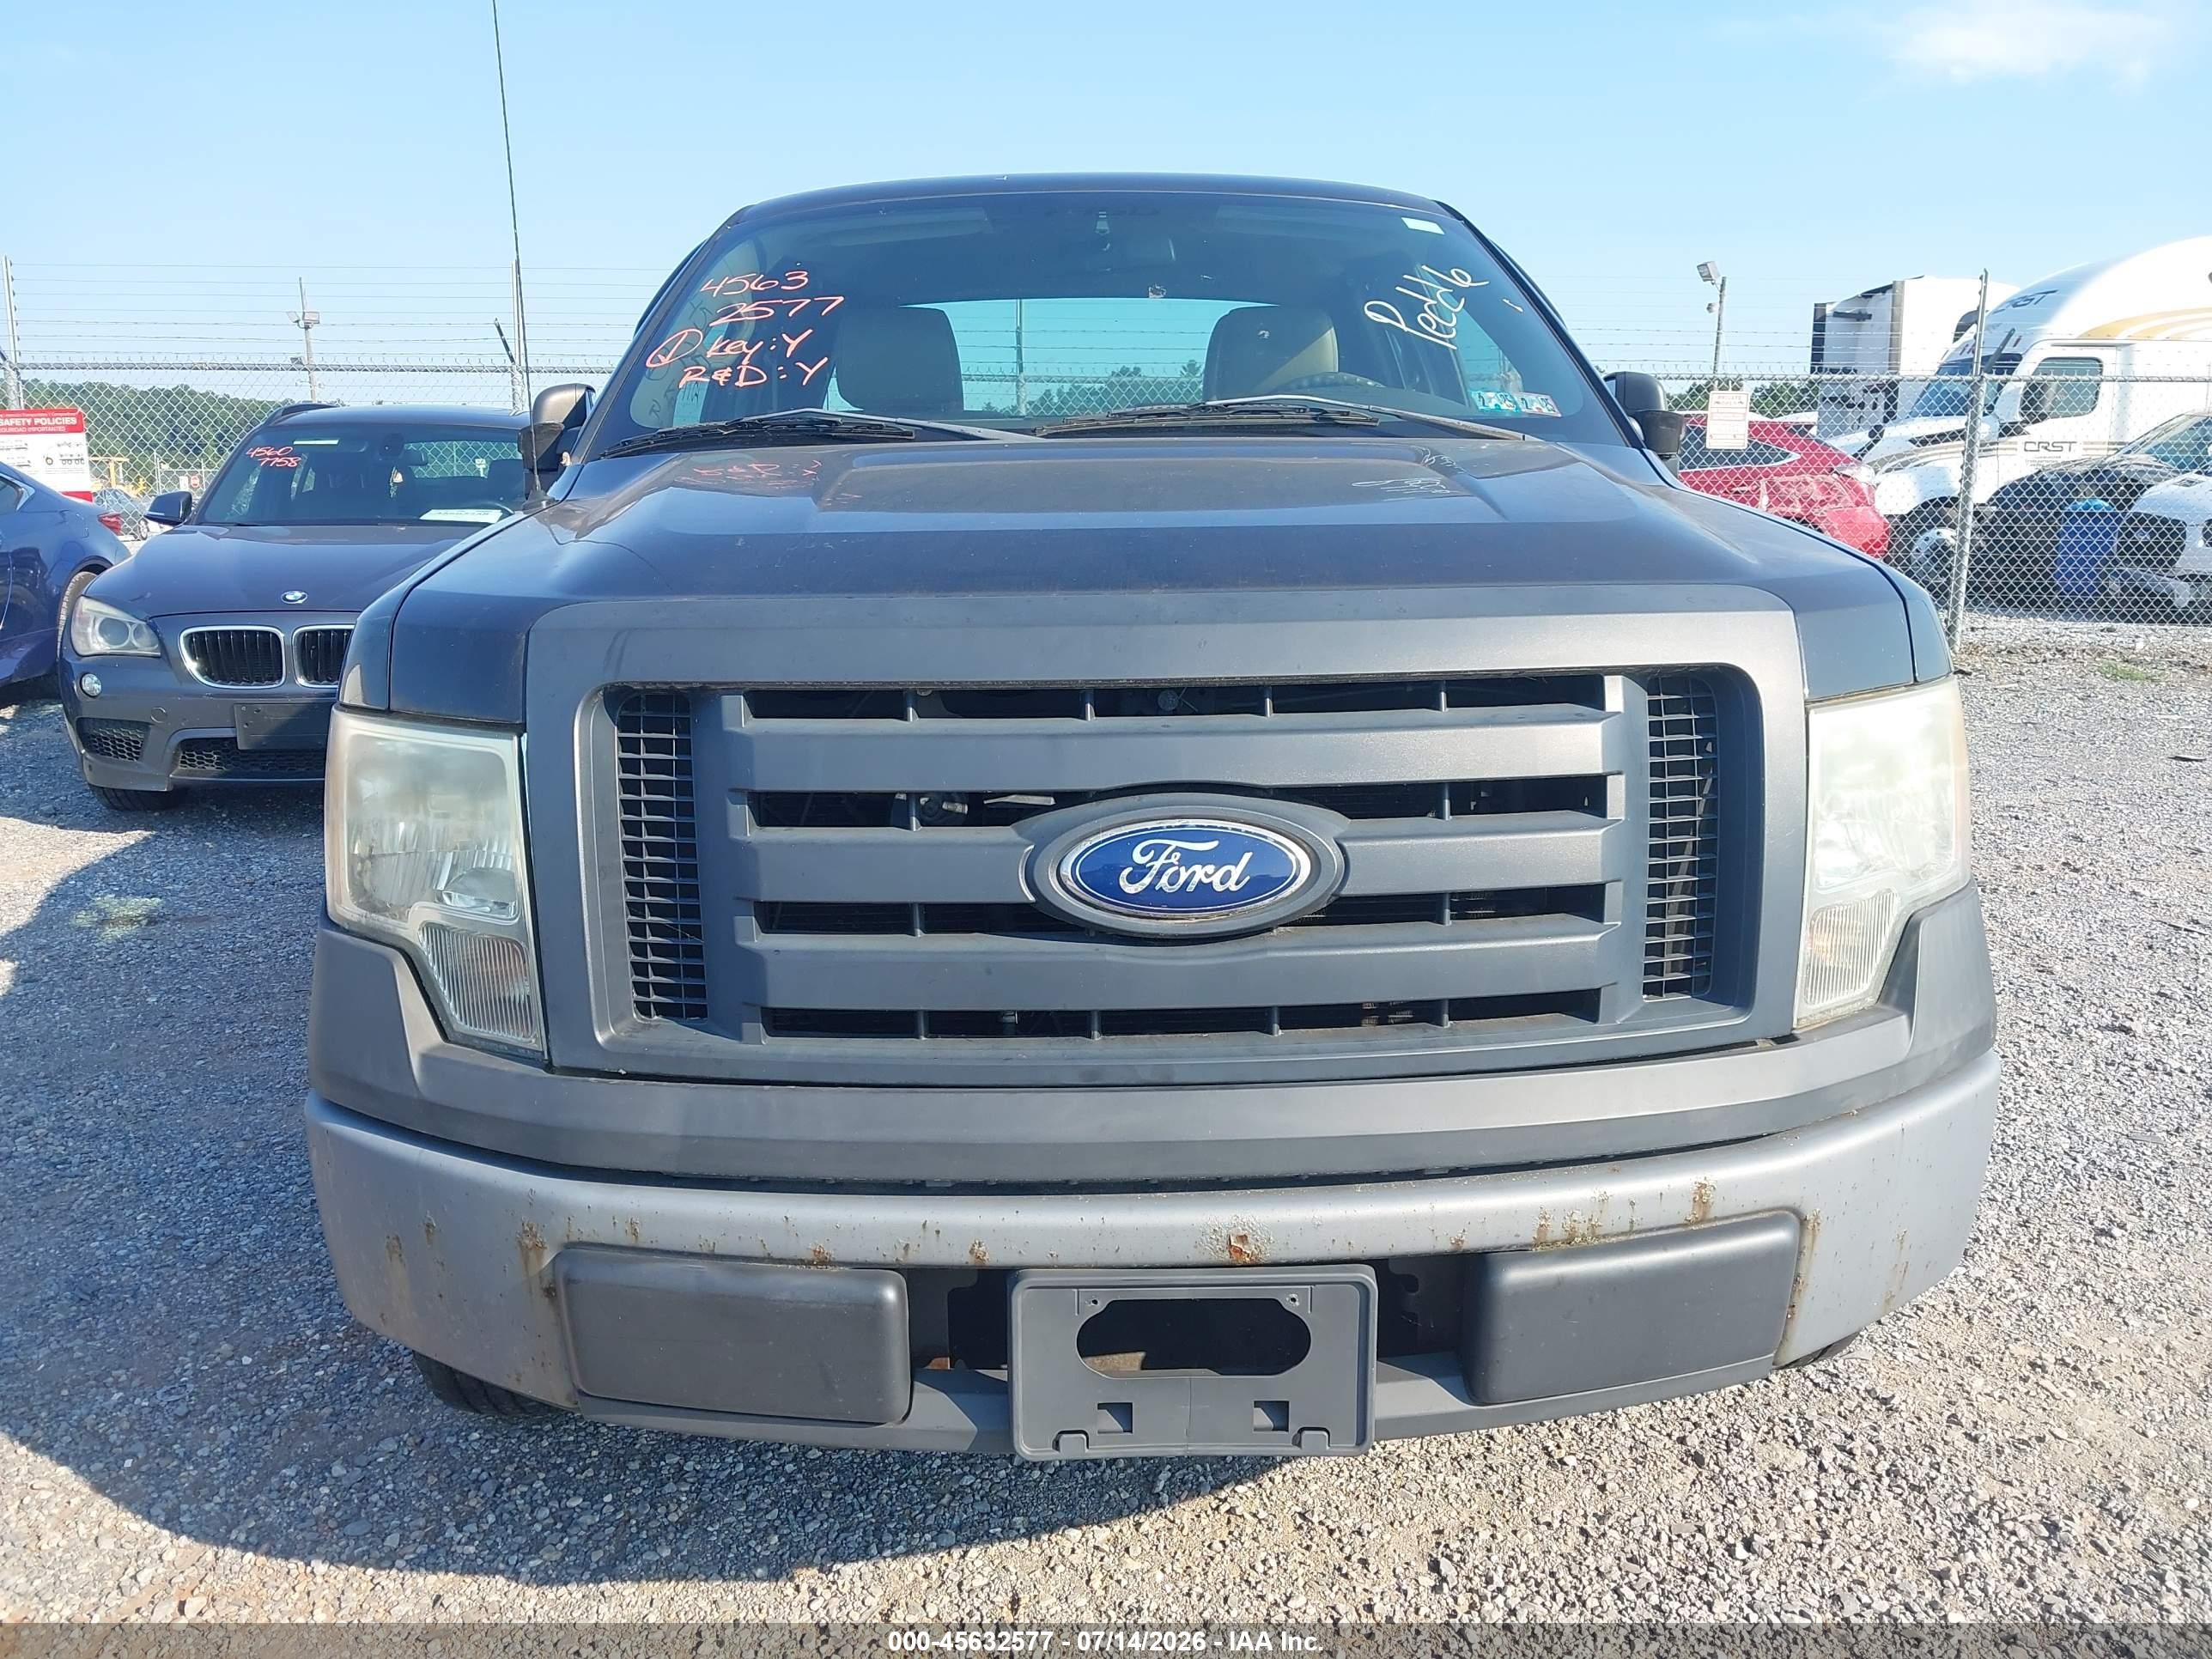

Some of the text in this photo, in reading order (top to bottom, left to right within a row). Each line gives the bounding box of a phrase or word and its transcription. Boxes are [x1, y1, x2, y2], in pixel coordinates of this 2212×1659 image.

[700, 270, 809, 297] 4563
[709, 295, 845, 327] 2577
[34, 417, 77, 426] POLICIES
[2024, 441, 2077, 452] CRST
[246, 447, 294, 459] 4560
[258, 456, 302, 467] 7758
[1119, 839, 1254, 894] Ford
